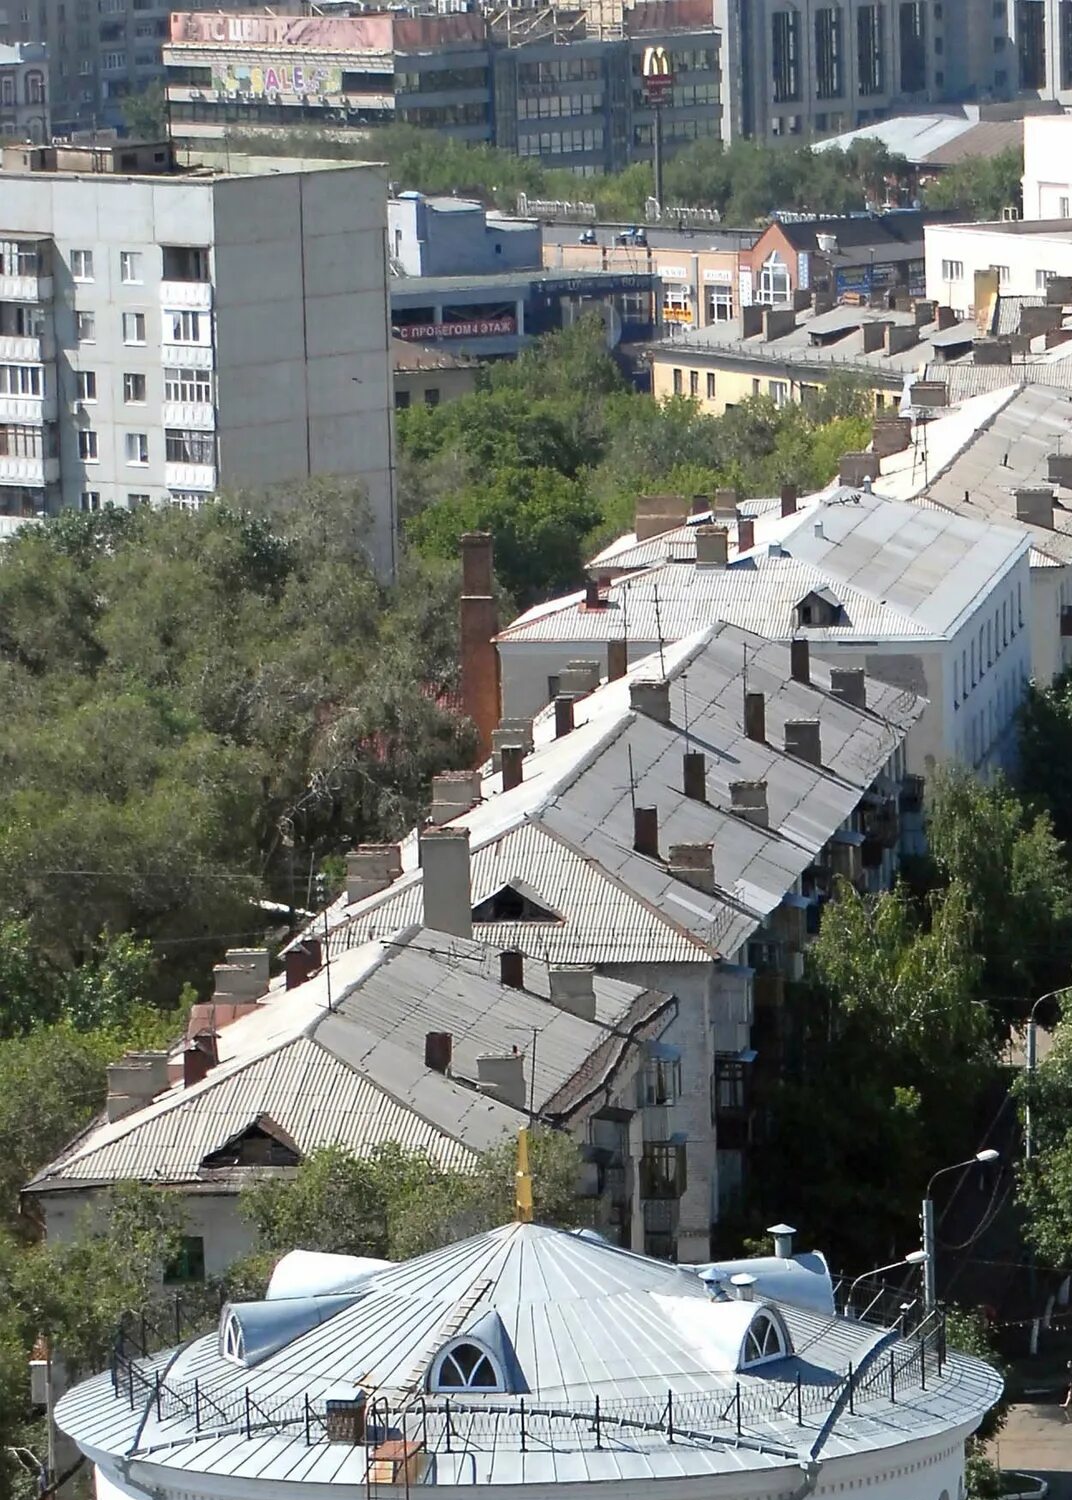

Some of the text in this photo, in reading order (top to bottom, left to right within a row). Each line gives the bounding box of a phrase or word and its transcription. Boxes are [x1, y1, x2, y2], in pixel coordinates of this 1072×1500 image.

[250, 65, 305, 94] SALE
[411, 324, 472, 338] ПРОБЕГОМ
[480, 321, 512, 334] ЭТАЖ
